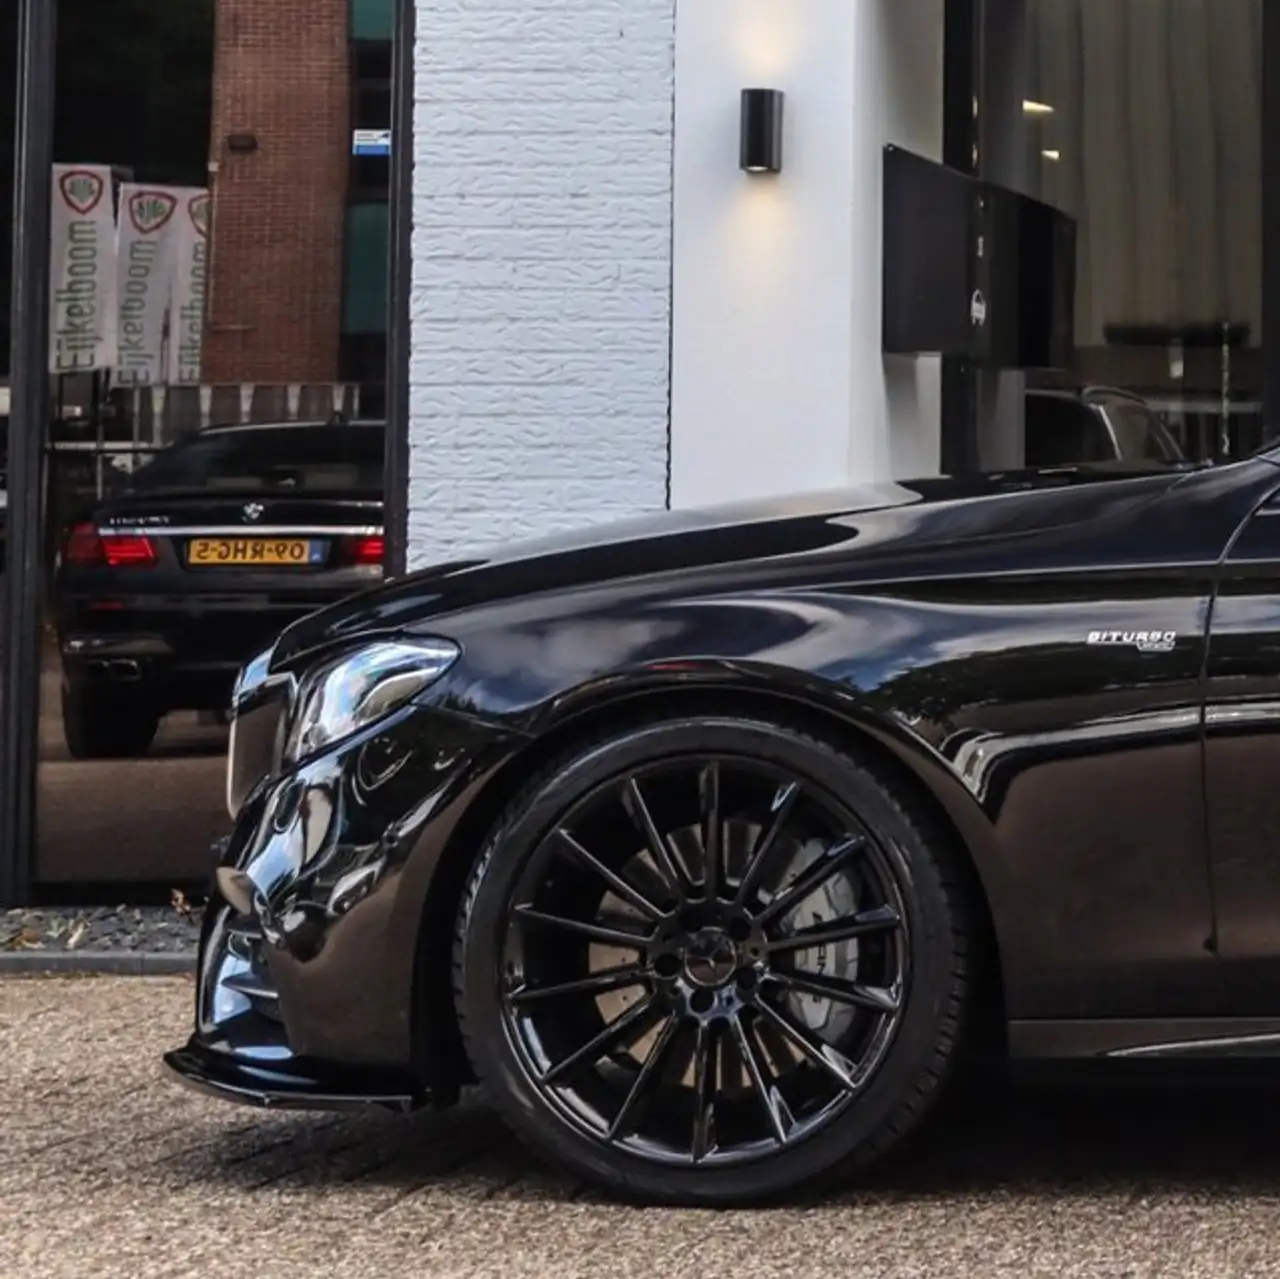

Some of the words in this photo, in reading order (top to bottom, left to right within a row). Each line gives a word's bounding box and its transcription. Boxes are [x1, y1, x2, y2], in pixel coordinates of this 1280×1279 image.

[55, 219, 104, 371] Eijkelboom
[118, 239, 158, 385] Eijkelboom
[1087, 631, 1176, 644] BITURBO
